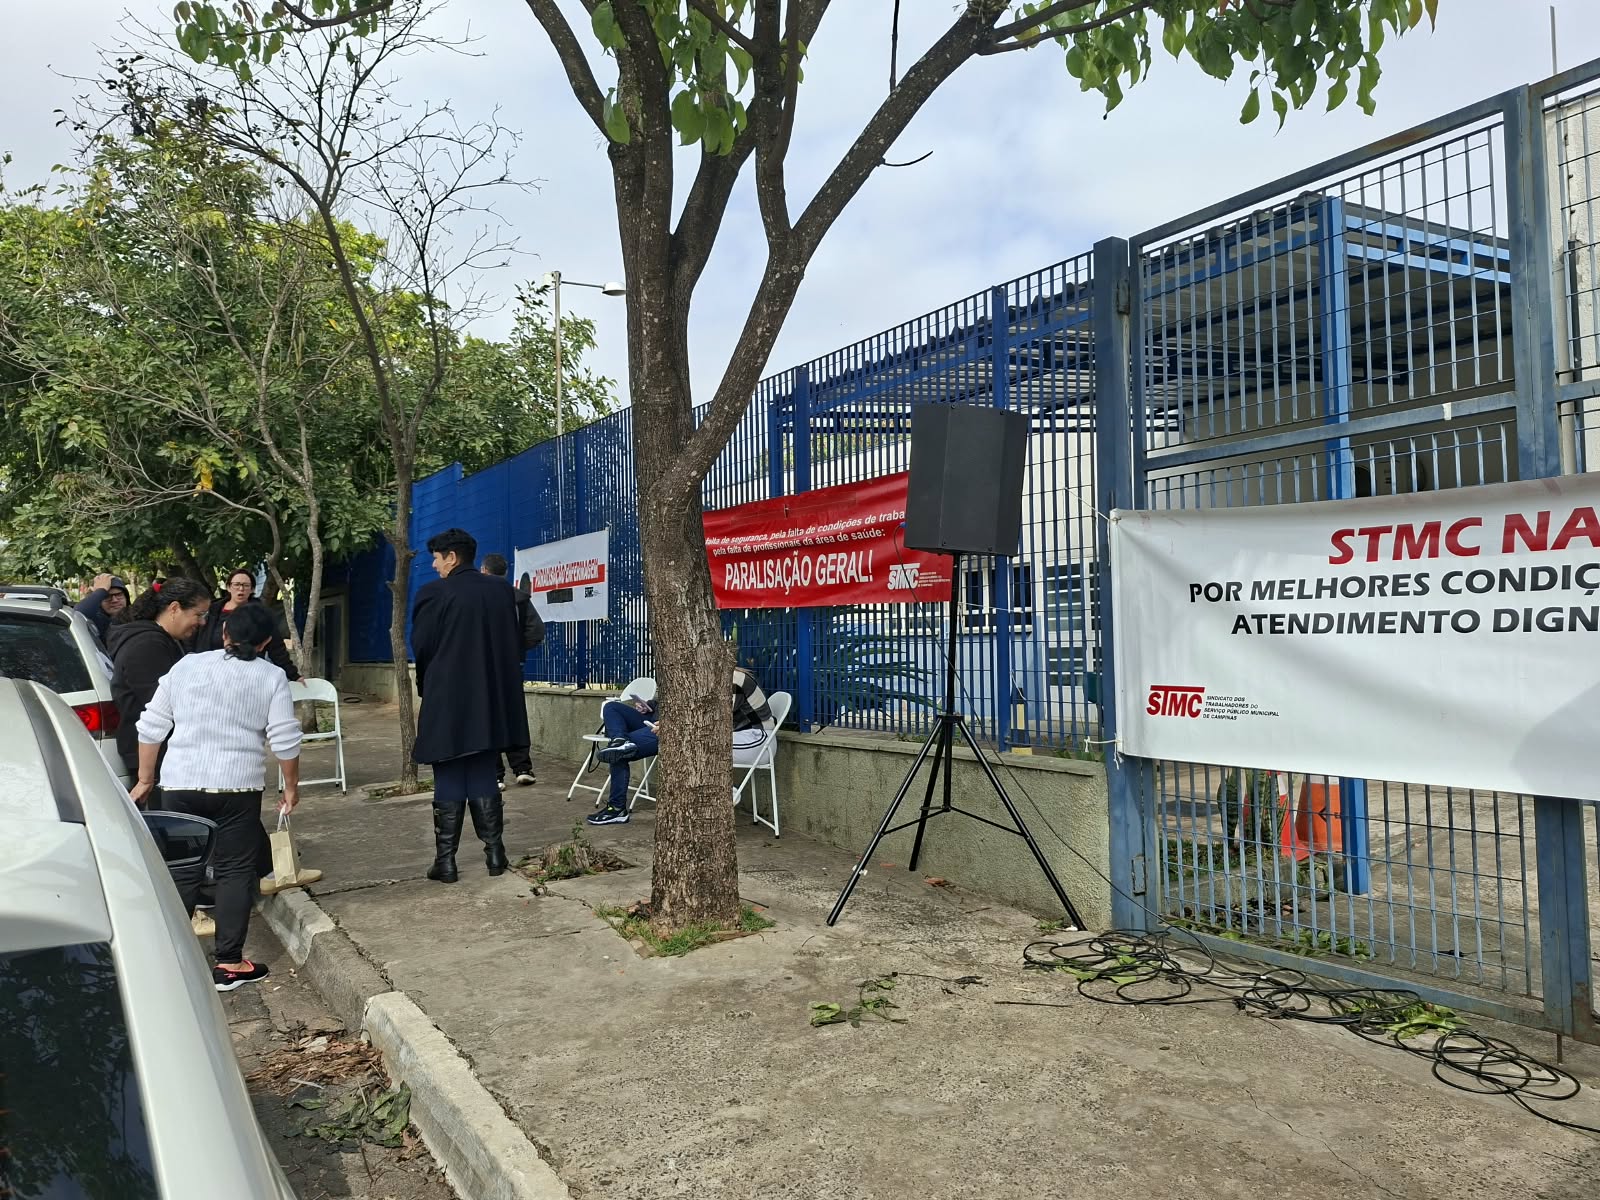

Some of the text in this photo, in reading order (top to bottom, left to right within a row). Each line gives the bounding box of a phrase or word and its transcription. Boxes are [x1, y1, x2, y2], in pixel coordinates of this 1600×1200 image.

[712, 528, 886, 557] pela falta de profissionais da área de saúde:
[720, 536, 730, 544] de
[770, 530, 786, 540] pela
[788, 527, 804, 538] falta
[806, 526, 816, 534] de
[817, 518, 862, 532] condições
[864, 515, 876, 525] de
[879, 510, 905, 522] traba
[1328, 506, 1600, 565] STMC NA
[724, 550, 811, 595] PARALISAÇÃO
[815, 549, 873, 586] GERAL!
[887, 562, 920, 590] STMC
[1190, 563, 1600, 603] POR MELHORES CONDIÇ
[1231, 605, 1600, 634] ATENDIMENTO DIGN
[1146, 685, 1205, 718] STMC
